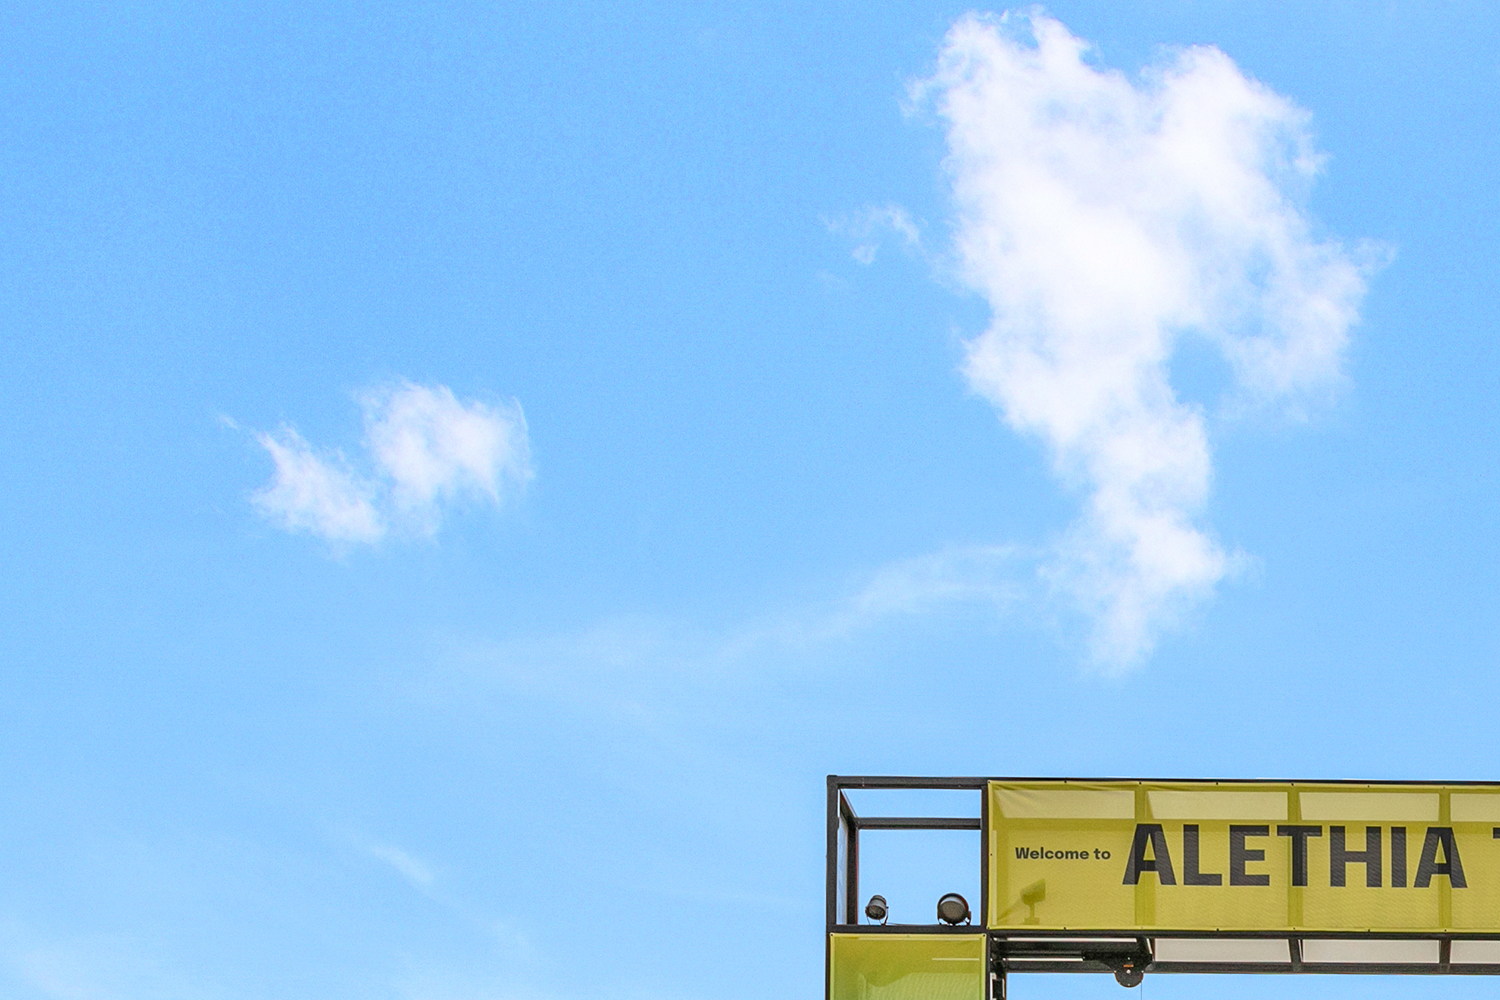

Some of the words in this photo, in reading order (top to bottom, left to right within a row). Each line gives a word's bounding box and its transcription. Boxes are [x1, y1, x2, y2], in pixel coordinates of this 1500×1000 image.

[1014, 846, 1090, 860] Welcome
[1093, 847, 1112, 860] to
[1121, 823, 1469, 888] ALETHIA
